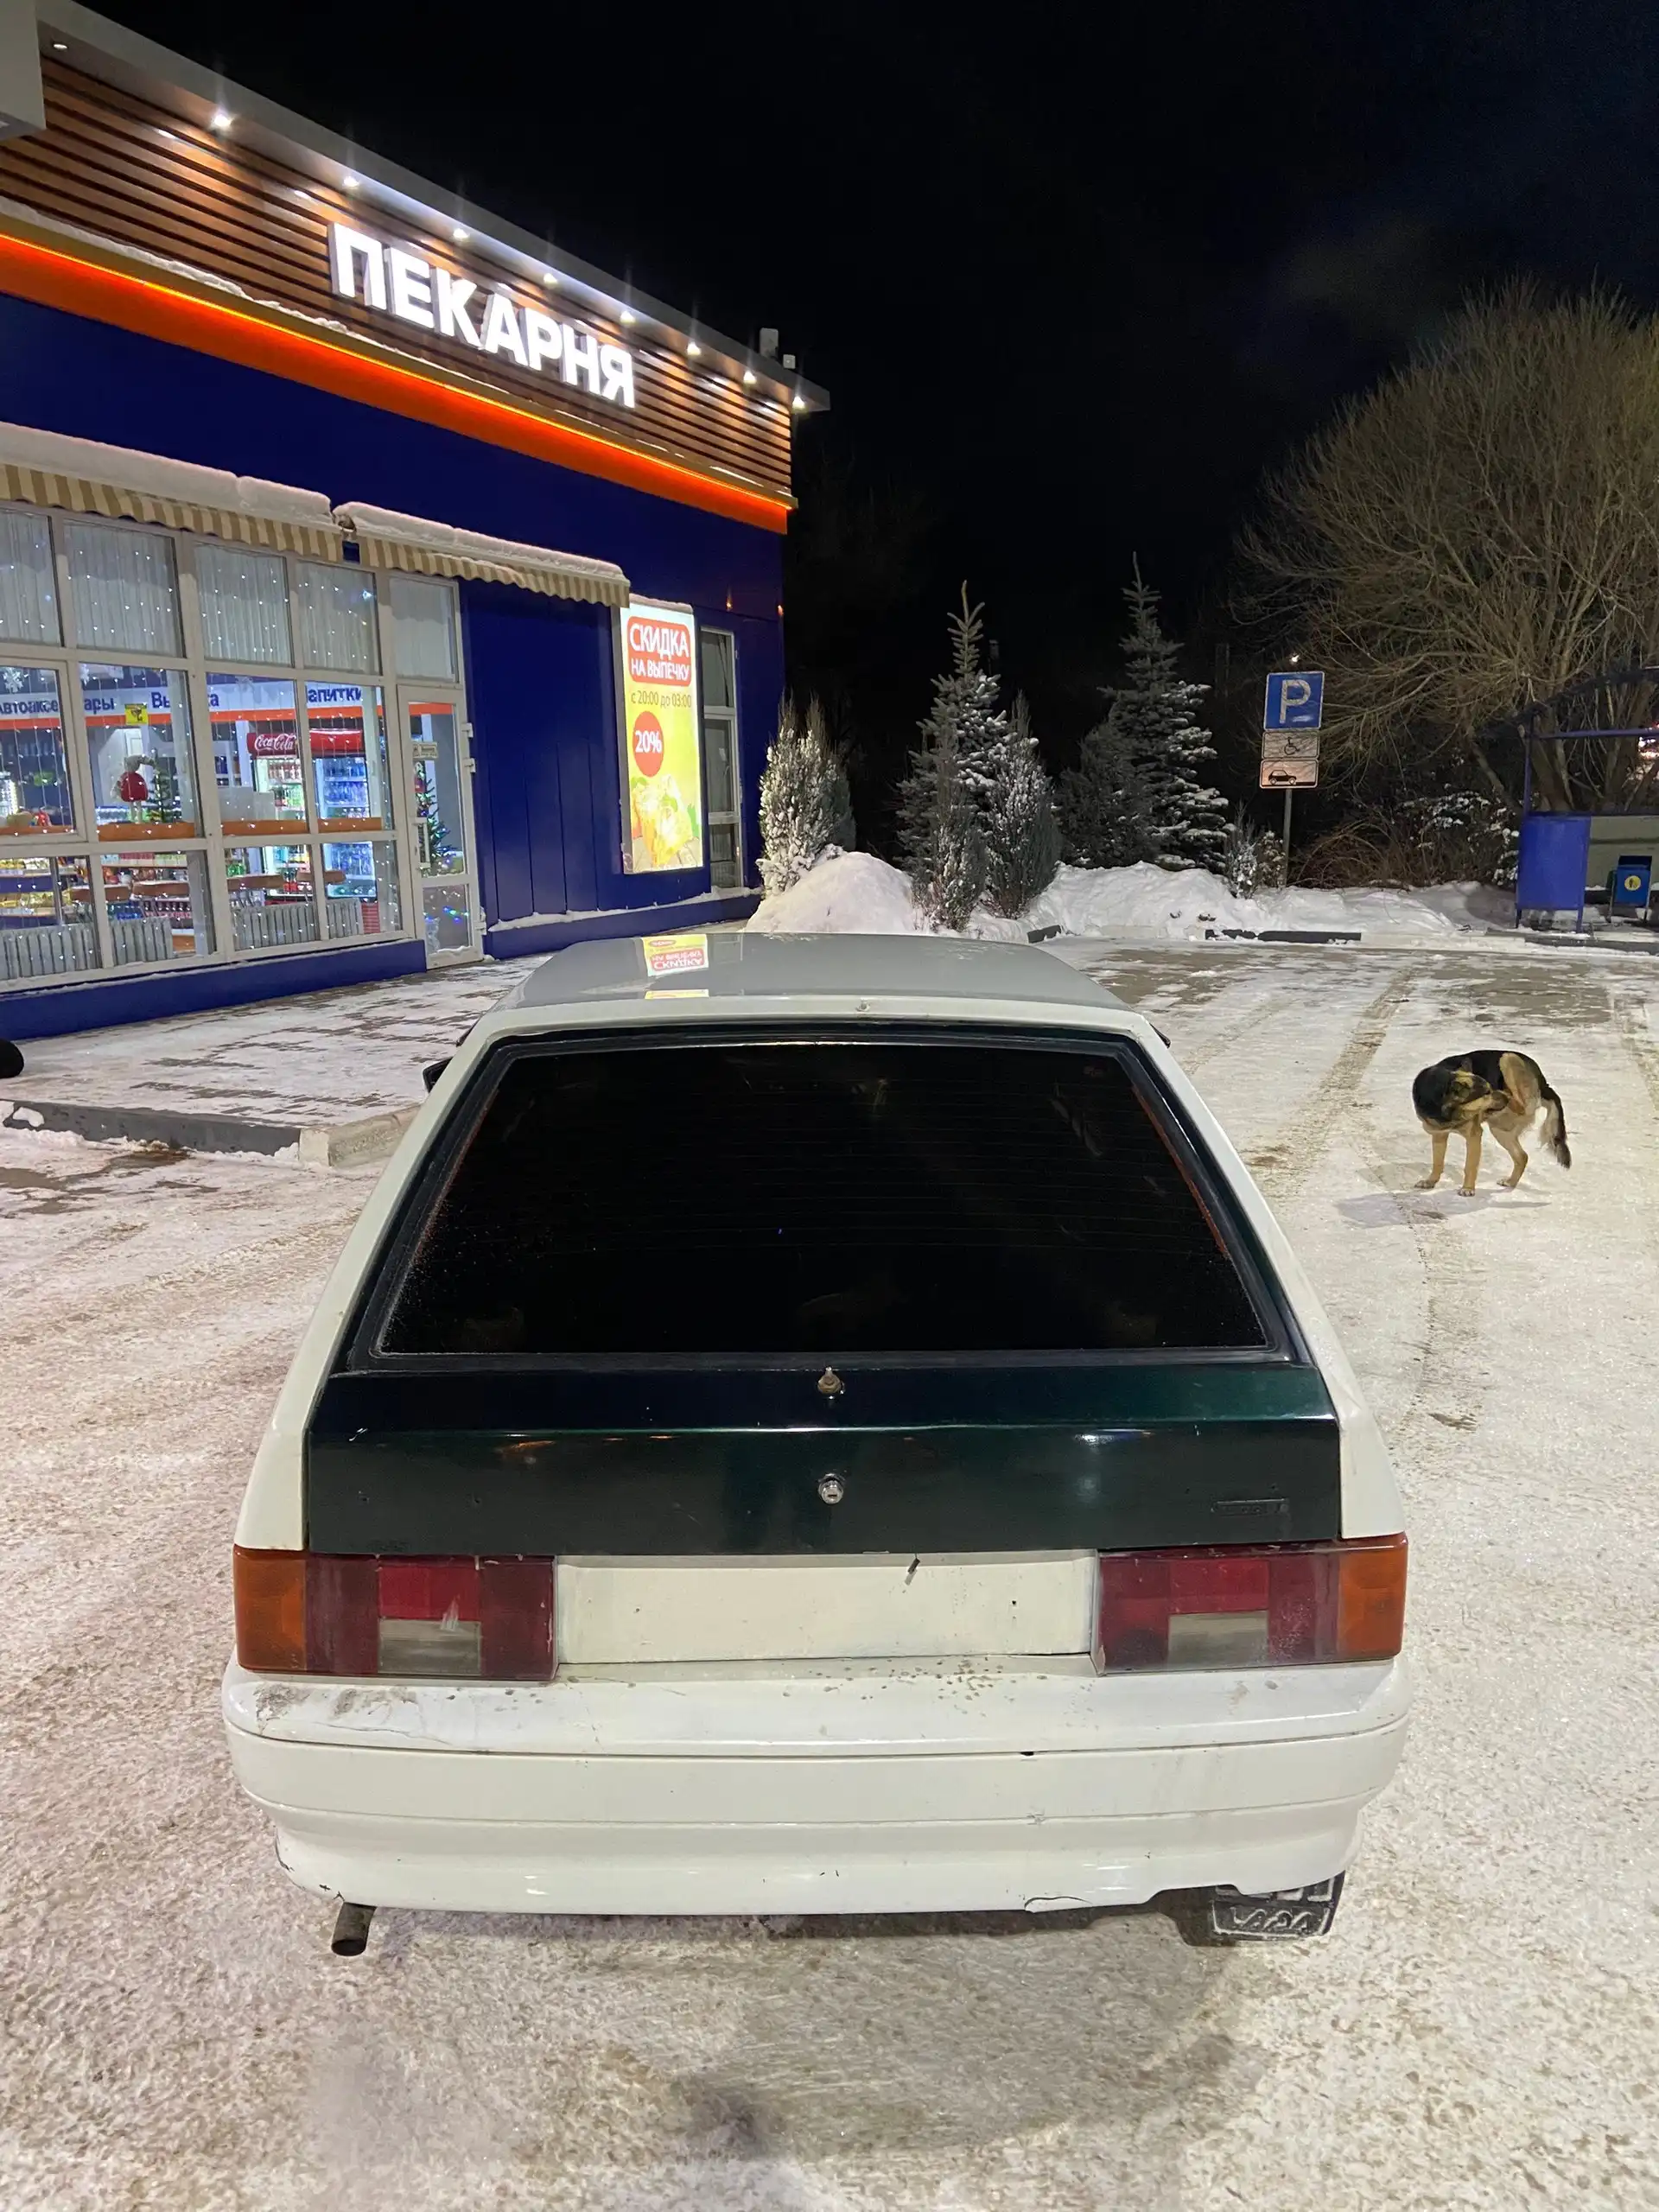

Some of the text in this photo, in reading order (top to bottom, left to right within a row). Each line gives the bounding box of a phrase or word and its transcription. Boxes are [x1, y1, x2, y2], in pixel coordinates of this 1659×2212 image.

[328, 221, 636, 409] ПЕКАРНЯ
[629, 623, 690, 660] СКИДКА
[631, 658, 690, 681] НА ВЫПЕЧКУ
[305, 685, 361, 702] апитки
[631, 690, 692, 709] с 20:00 до 03:00
[1279, 678, 1312, 724] P
[635, 730, 663, 753] 20%
